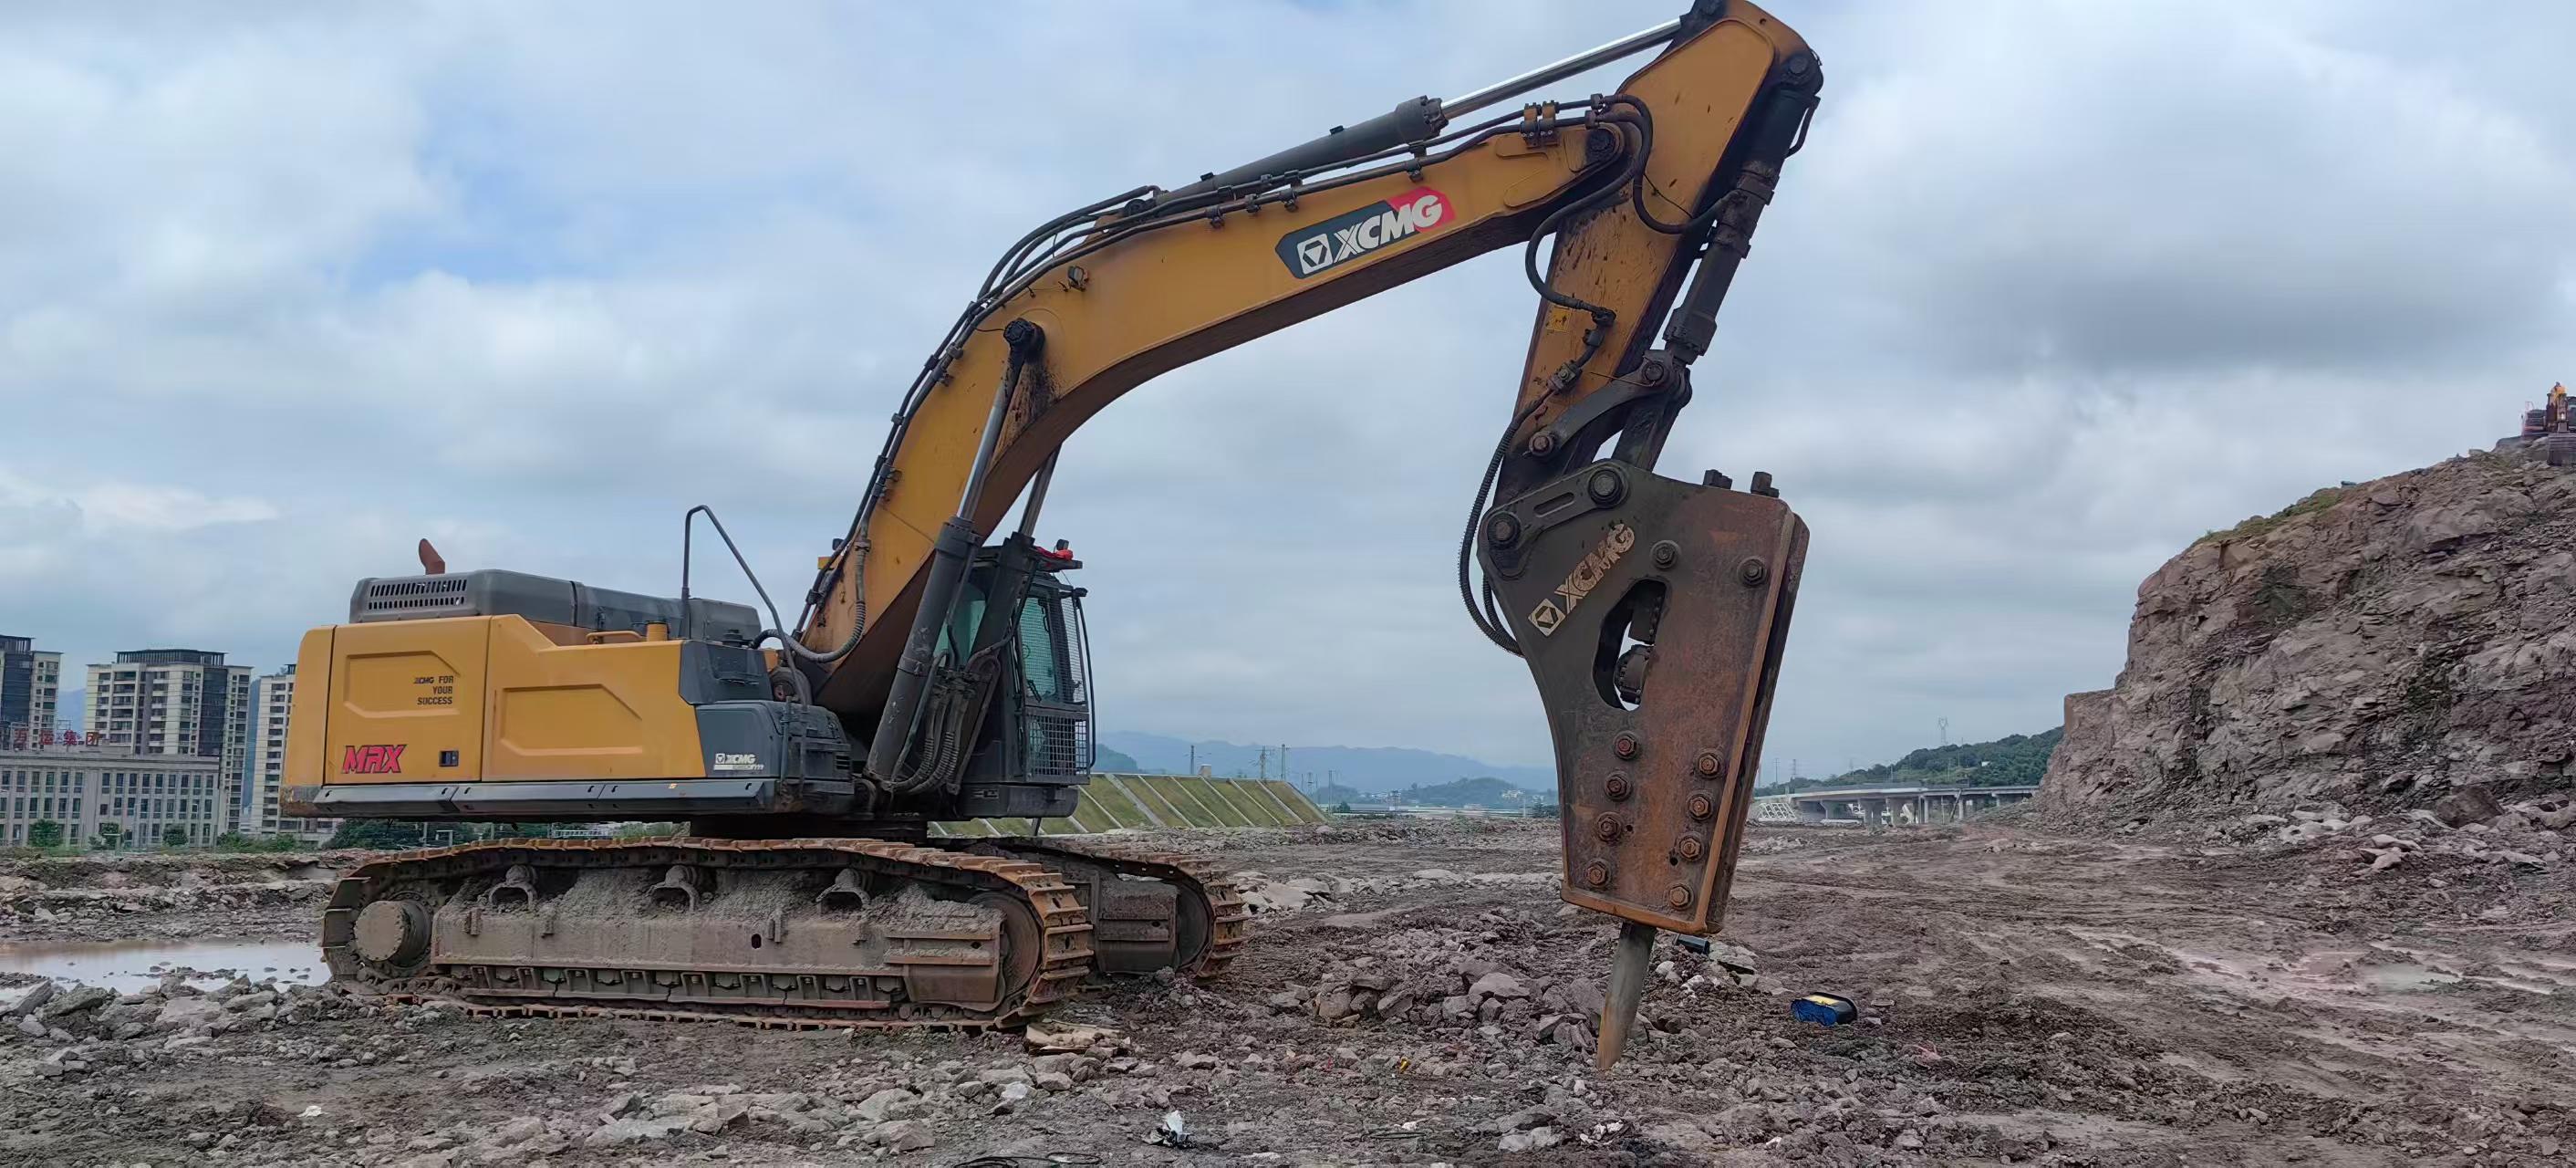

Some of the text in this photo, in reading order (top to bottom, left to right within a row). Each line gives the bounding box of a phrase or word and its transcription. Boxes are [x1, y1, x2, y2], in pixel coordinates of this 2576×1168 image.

[1334, 194, 1443, 263] XCMG
[1554, 524, 1635, 614] XCMG
[438, 675, 454, 684] FOR
[432, 685, 453, 694] YOUR
[417, 696, 452, 705] SUCCESS
[341, 744, 408, 774] MAX
